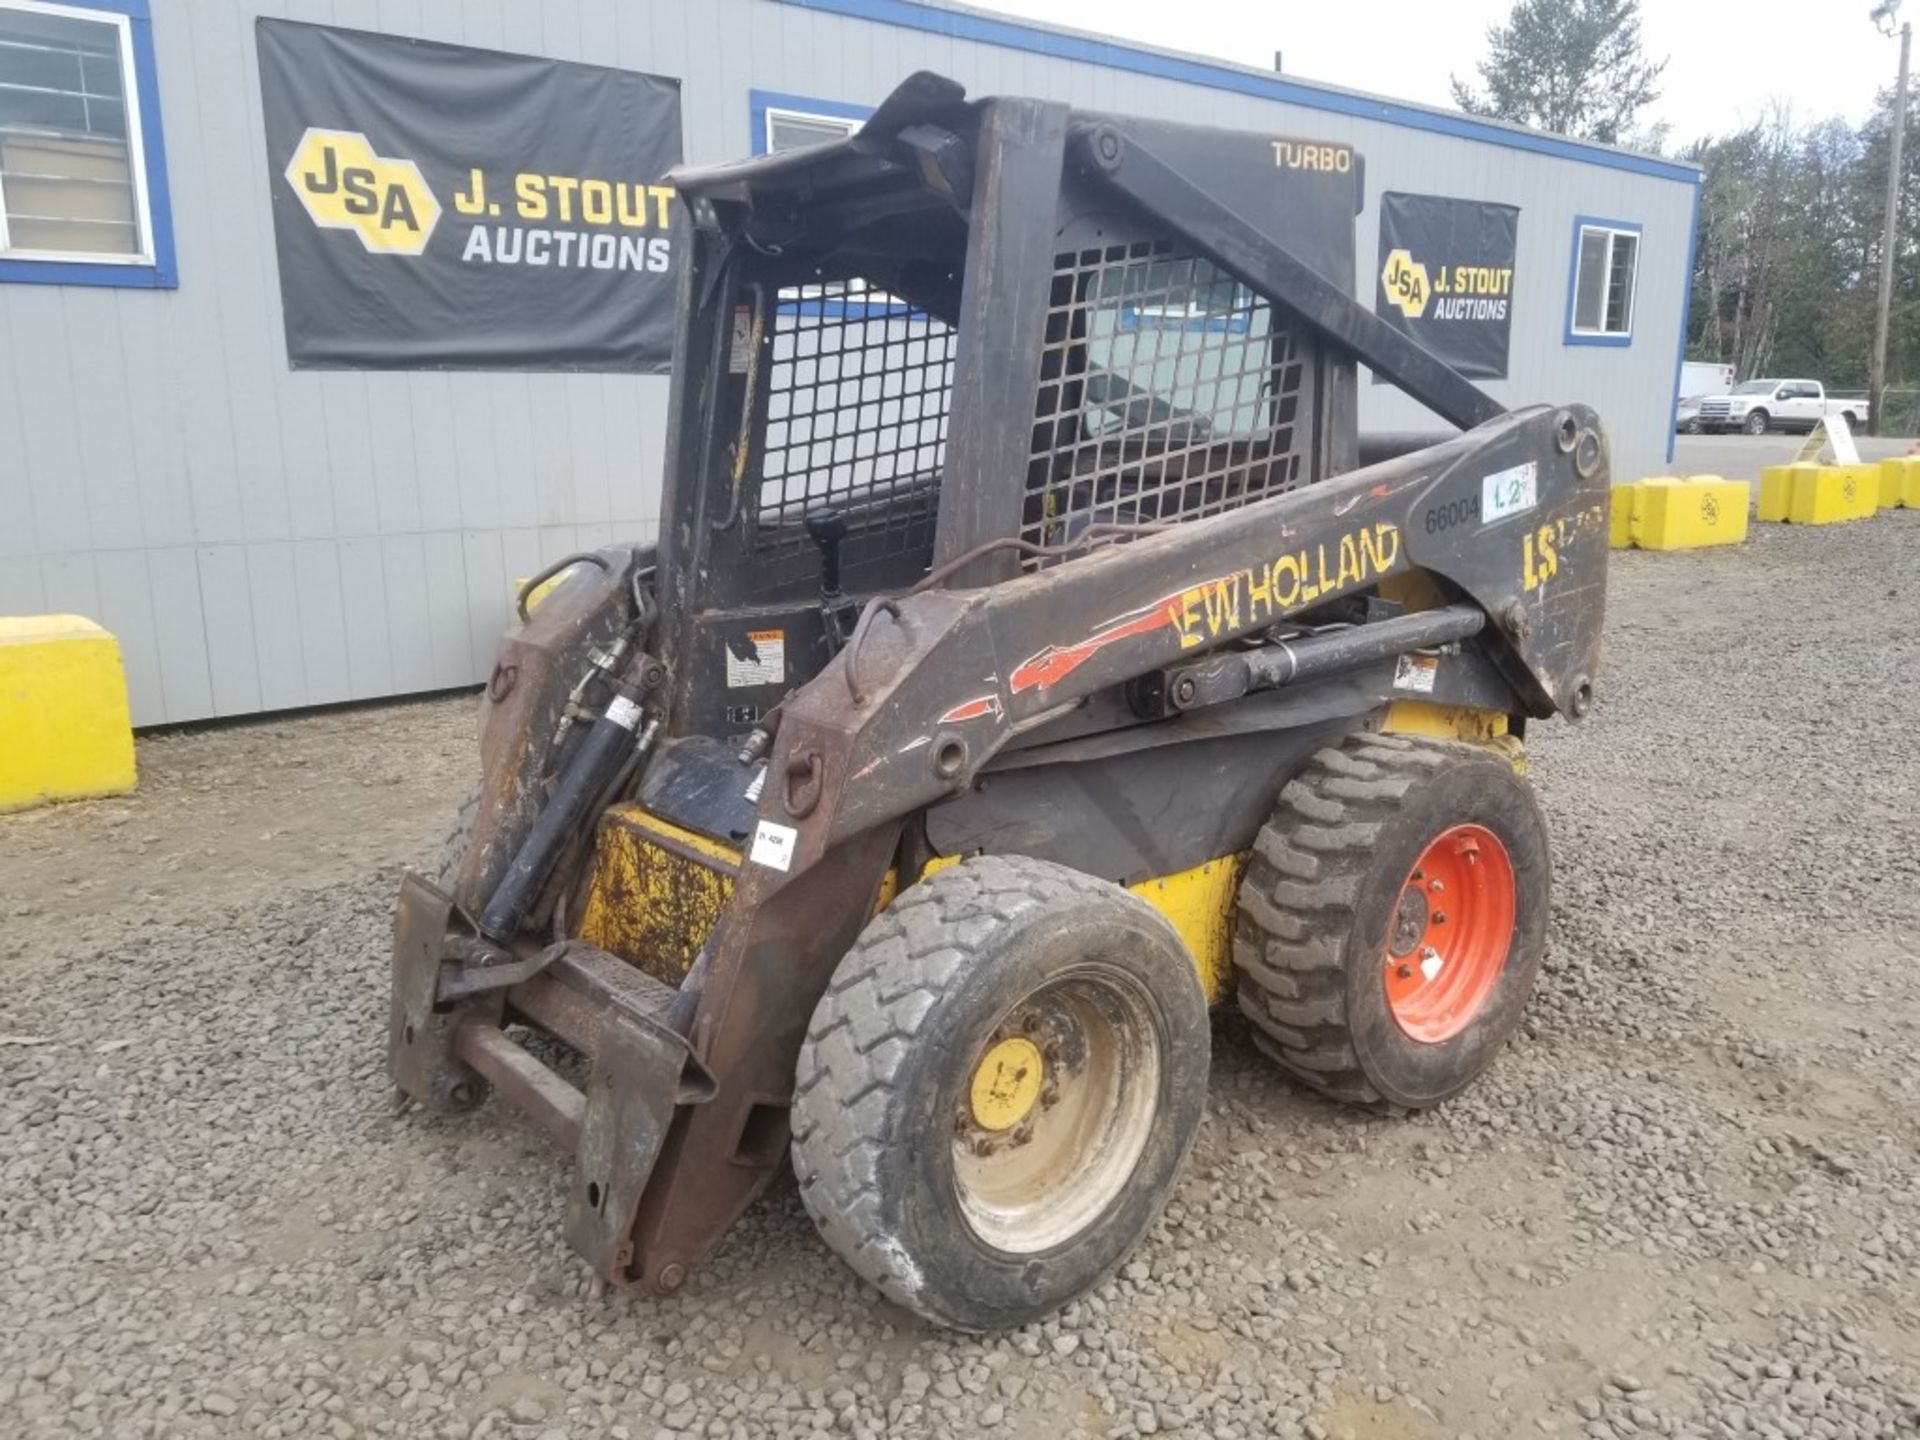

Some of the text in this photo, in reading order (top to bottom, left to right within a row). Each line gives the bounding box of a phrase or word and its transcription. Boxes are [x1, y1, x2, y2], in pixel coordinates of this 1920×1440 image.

[1271, 141, 1350, 172] TURBO
[304, 146, 421, 232] JSA
[454, 168, 676, 229] J. STOUT
[462, 225, 671, 272] AUCTIONS
[1388, 259, 1423, 304] JSA
[1434, 266, 1512, 295] J. STOUT
[1434, 297, 1507, 320] AUCTIONS
[1425, 494, 1480, 535] 66004
[1248, 522, 1399, 623] HOLLAND
